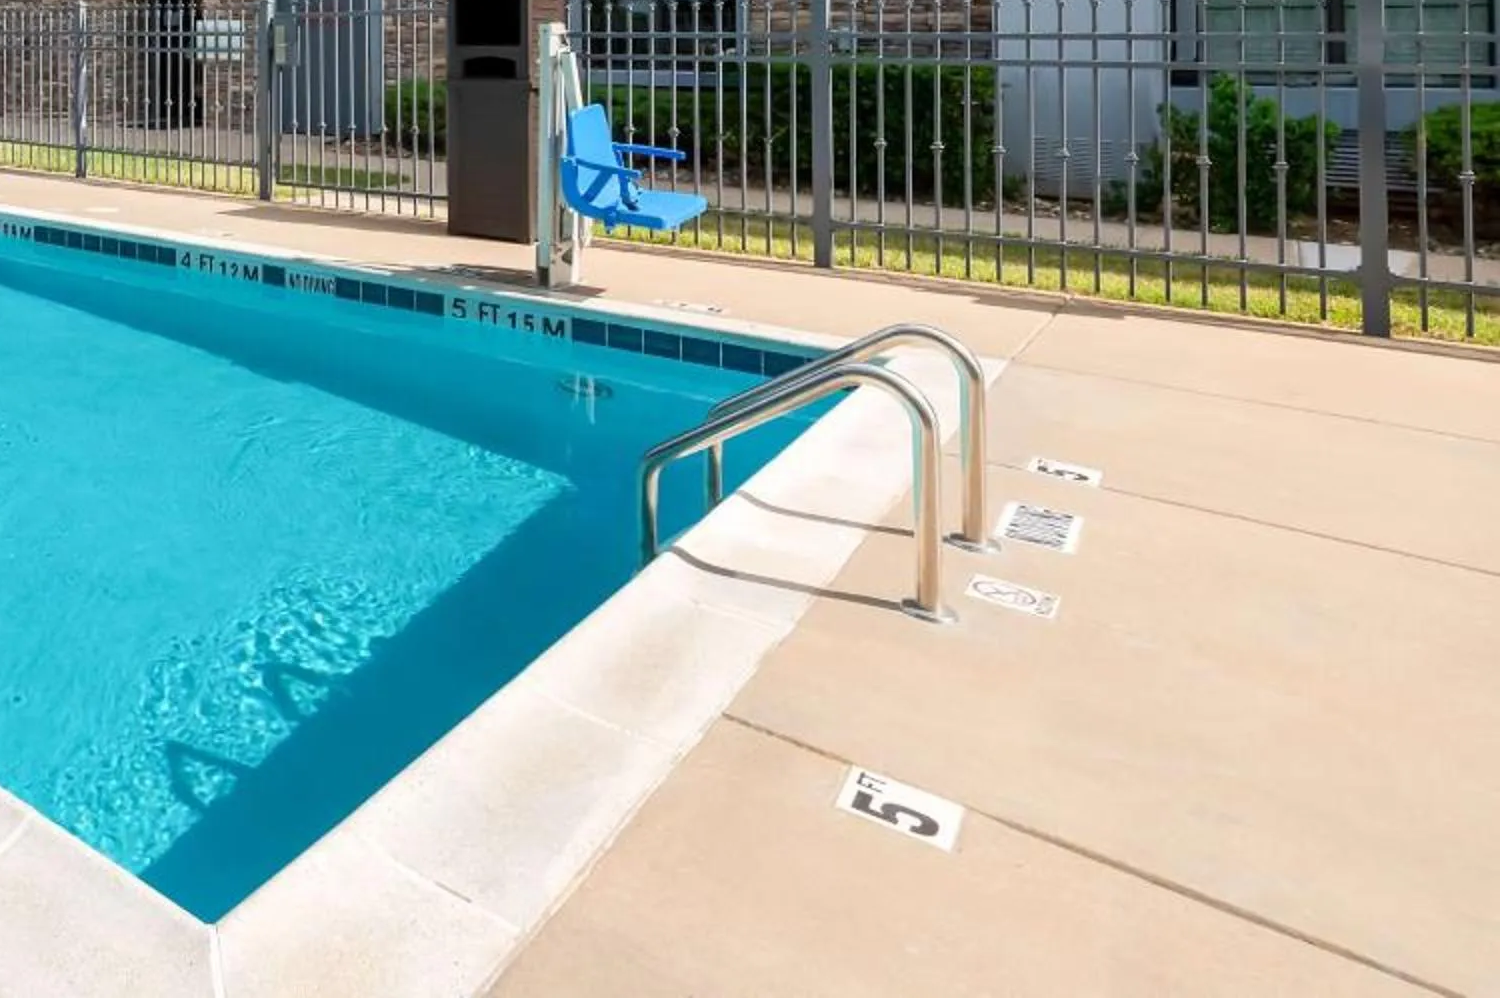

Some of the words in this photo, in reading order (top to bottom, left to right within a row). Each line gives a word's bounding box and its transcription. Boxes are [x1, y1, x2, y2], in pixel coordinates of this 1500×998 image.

[181, 251, 191, 268] 4
[452, 297, 466, 319] 5
[478, 302, 500, 325] FT
[851, 789, 940, 837] 5
